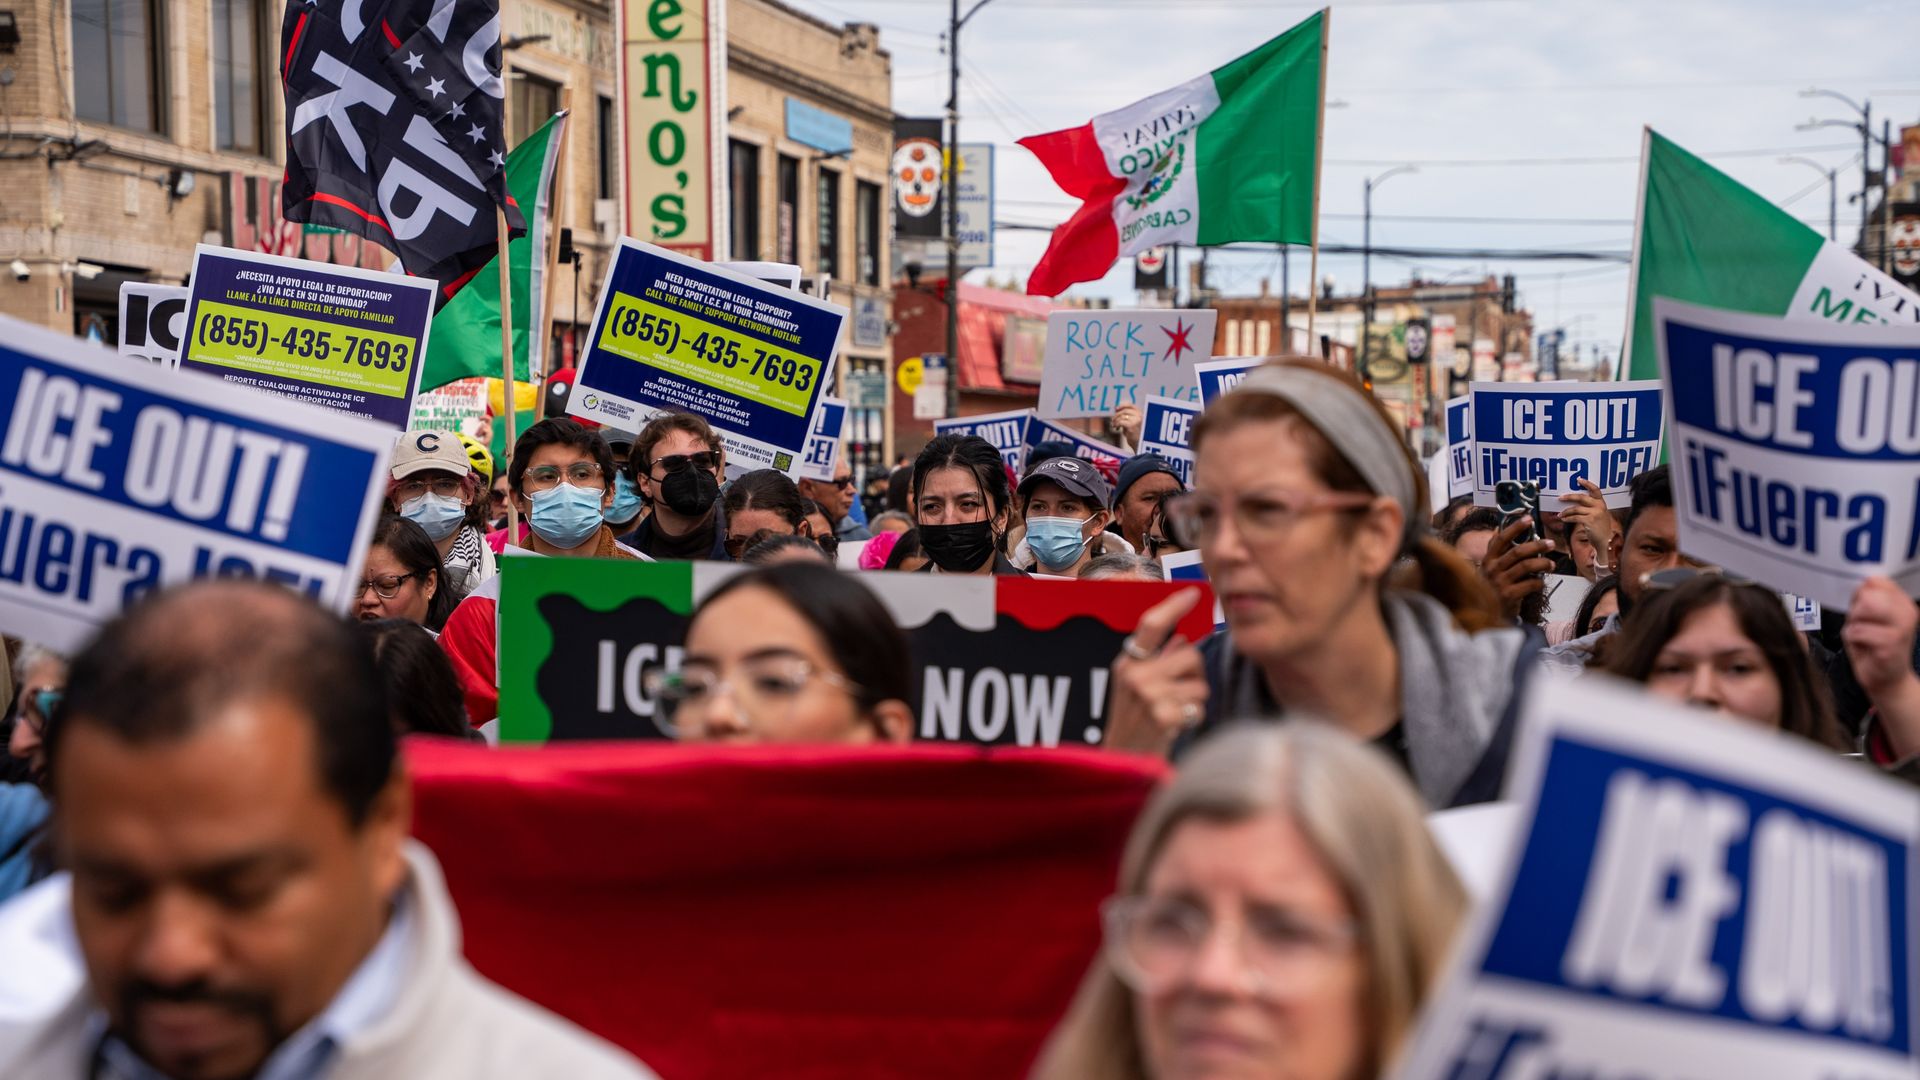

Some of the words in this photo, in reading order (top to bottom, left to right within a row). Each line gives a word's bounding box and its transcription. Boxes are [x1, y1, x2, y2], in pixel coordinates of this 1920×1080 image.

[236, 270, 274, 284] ¿NECESITA
[276, 276, 300, 288] APOYO
[302, 280, 324, 292] LEGAL
[326, 284, 336, 293] DE
[256, 284, 274, 294] ¿VIO
[276, 288, 280, 296] A
[282, 288, 297, 298] ICE
[296, 290, 306, 300] EN
[307, 292, 318, 301] SU
[319, 294, 368, 309] COMUNIDAD?
[664, 272, 684, 284] NEED
[684, 278, 732, 300] DEPORTATION
[732, 294, 754, 308] LEGAL
[754, 301, 792, 320] SUPPORT?
[226, 290, 249, 302] LLAME
[250, 294, 256, 302] A
[258, 295, 267, 304] LA
[268, 294, 289, 308] LÍNEA
[291, 300, 321, 313] DIRECTA
[323, 305, 332, 314] DE
[334, 307, 359, 318] APOYO
[360, 311, 394, 324] FAMILIAR
[645, 288, 663, 300] CALL
[664, 294, 679, 305] THE
[679, 298, 704, 312] FAMILY
[704, 306, 738, 324] SUPPORT
[738, 318, 772, 335] NETWORK
[772, 330, 802, 344] HOTLINE
[654, 279, 668, 290] DID
[669, 284, 684, 296] YOU
[684, 290, 704, 302] SPOT
[704, 295, 721, 308] I.C.E.
[722, 302, 732, 311] IN
[732, 304, 752, 318] YOUR
[752, 311, 800, 333] COMMUNITY?
[199, 313, 409, 373] (855)-435-7693
[611, 305, 814, 392] (855)-435-7693
[1066, 320, 1144, 352] ROCK
[1081, 352, 1155, 380] SALT
[224, 374, 257, 386] REPORTE
[258, 380, 300, 392] CUALQUIER
[300, 386, 342, 399] ACTIVIDAD
[342, 392, 352, 400] DE
[287, 392, 297, 400] DE
[298, 394, 350, 408] DEPORTACIÓN
[644, 380, 694, 402] DEPORTATION
[694, 396, 716, 409] LEGAL
[718, 404, 750, 419] SUPPORT
[658, 376, 686, 390] REPORT
[686, 385, 704, 397] I.C.E.
[706, 392, 740, 408] ACTIVITY
[1057, 384, 1139, 412] MELTS
[1712, 343, 1820, 449] ICE
[640, 388, 660, 399] LEGAL
[666, 396, 688, 408] SOCIAL
[689, 403, 715, 416] SERVICE
[716, 411, 750, 427] REFERRALS
[1502, 398, 1553, 440] ICE
[1564, 398, 1636, 440] OUT!
[1159, 410, 1193, 446] ICE
[1, 366, 124, 491] ICE
[123, 404, 310, 542] OUT!
[726, 438, 740, 448] MORE
[740, 444, 773, 458] INFORMATION
[920, 664, 1072, 749] NOW
[1560, 766, 1750, 1010] ICE
